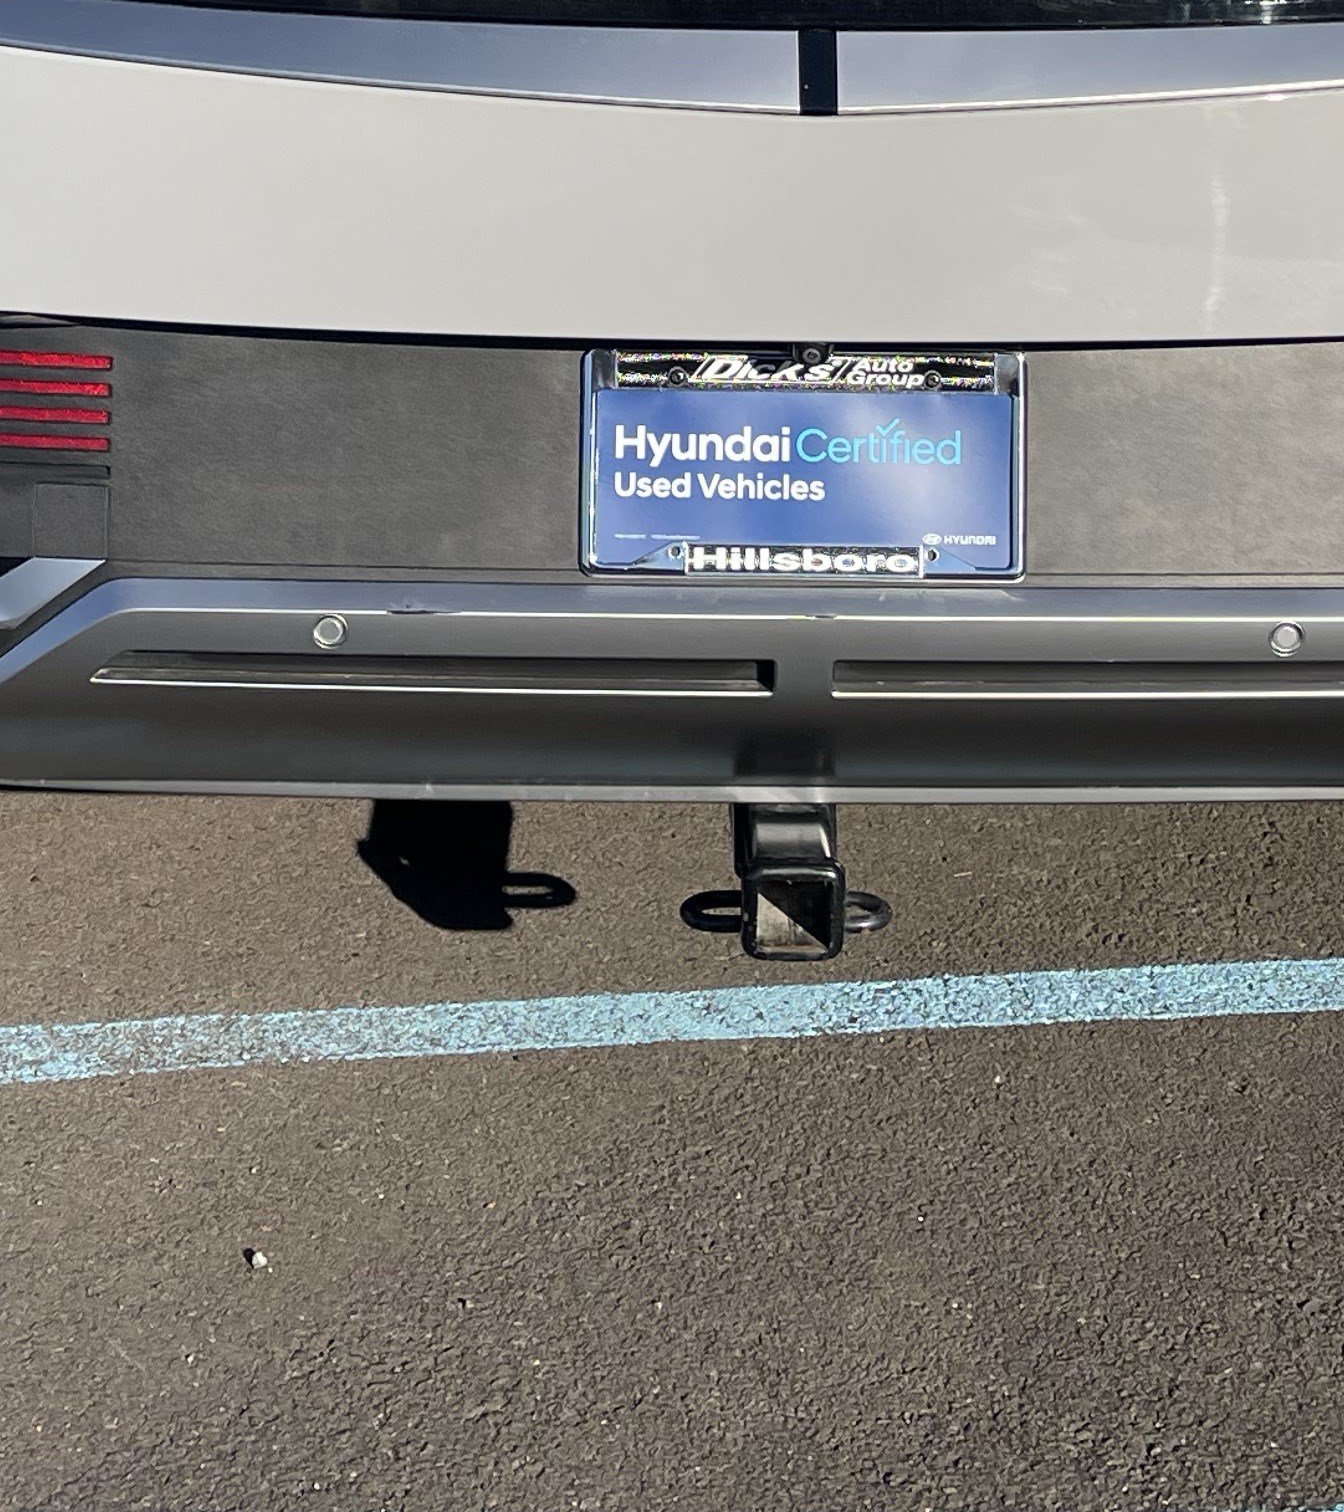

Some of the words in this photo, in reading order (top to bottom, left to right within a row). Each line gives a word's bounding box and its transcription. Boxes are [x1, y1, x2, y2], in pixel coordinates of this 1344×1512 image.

[856, 358, 914, 373] Auto
[847, 373, 926, 388] Group
[614, 425, 790, 467] Hyundai
[796, 418, 961, 465] Certified
[614, 472, 690, 498] Used
[697, 473, 825, 501] Vehicles
[943, 535, 997, 545] HYUNDAI
[690, 546, 917, 572] Hillsboro
